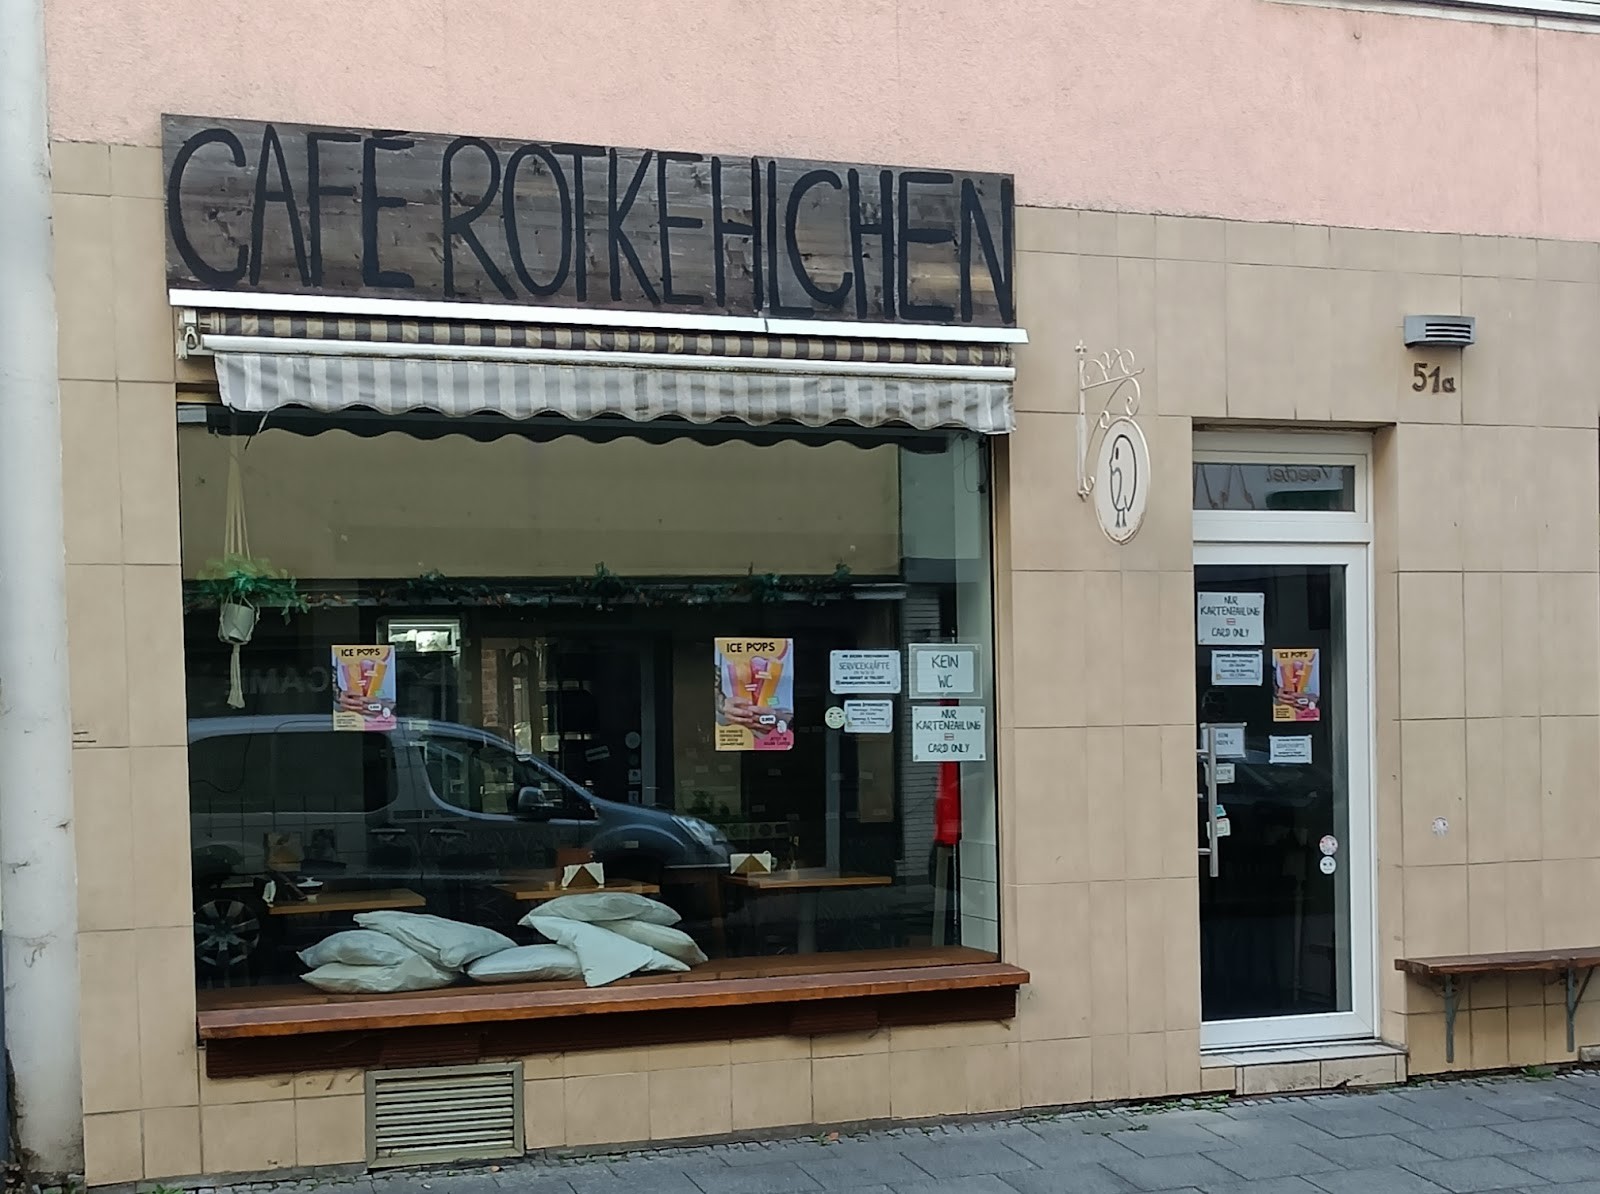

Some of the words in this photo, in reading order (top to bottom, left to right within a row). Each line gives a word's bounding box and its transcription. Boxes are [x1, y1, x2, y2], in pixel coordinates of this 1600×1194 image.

[168, 124, 415, 288] CAFÉ
[442, 136, 1014, 324] ROTKEHLCHEN
[1412, 362, 1456, 393] 51a
[1224, 596, 1239, 605] NUR
[1200, 606, 1260, 616] KARTENZAHLUNG
[1211, 627, 1230, 637] CARD
[1232, 628, 1249, 637] ONLY
[341, 648, 354, 657] ICE
[726, 643, 742, 653] ICE
[931, 654, 959, 668] KEIN
[937, 674, 953, 688] WC
[941, 709, 957, 719] NUR
[916, 720, 981, 731] KARTENZAHLUNG
[928, 743, 948, 753] CARD
[951, 743, 970, 753] ONLY
